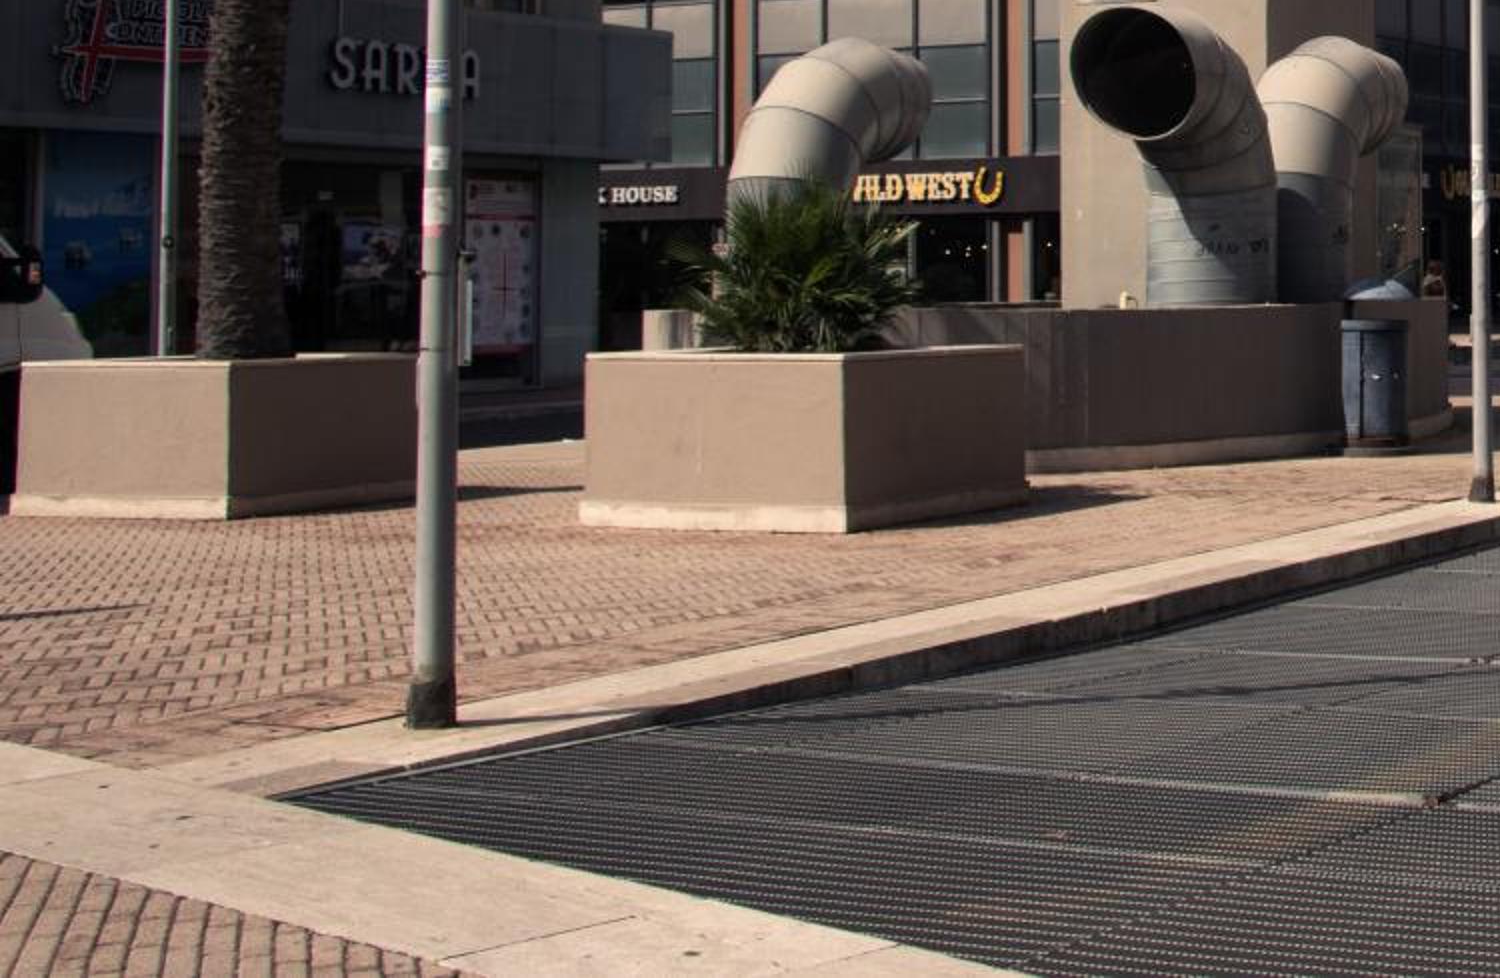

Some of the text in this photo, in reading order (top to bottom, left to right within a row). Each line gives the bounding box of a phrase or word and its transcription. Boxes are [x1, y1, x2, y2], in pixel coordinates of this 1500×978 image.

[331, 37, 480, 98] SARA
[612, 185, 678, 204] HOUSE
[902, 171, 975, 200] WEST
